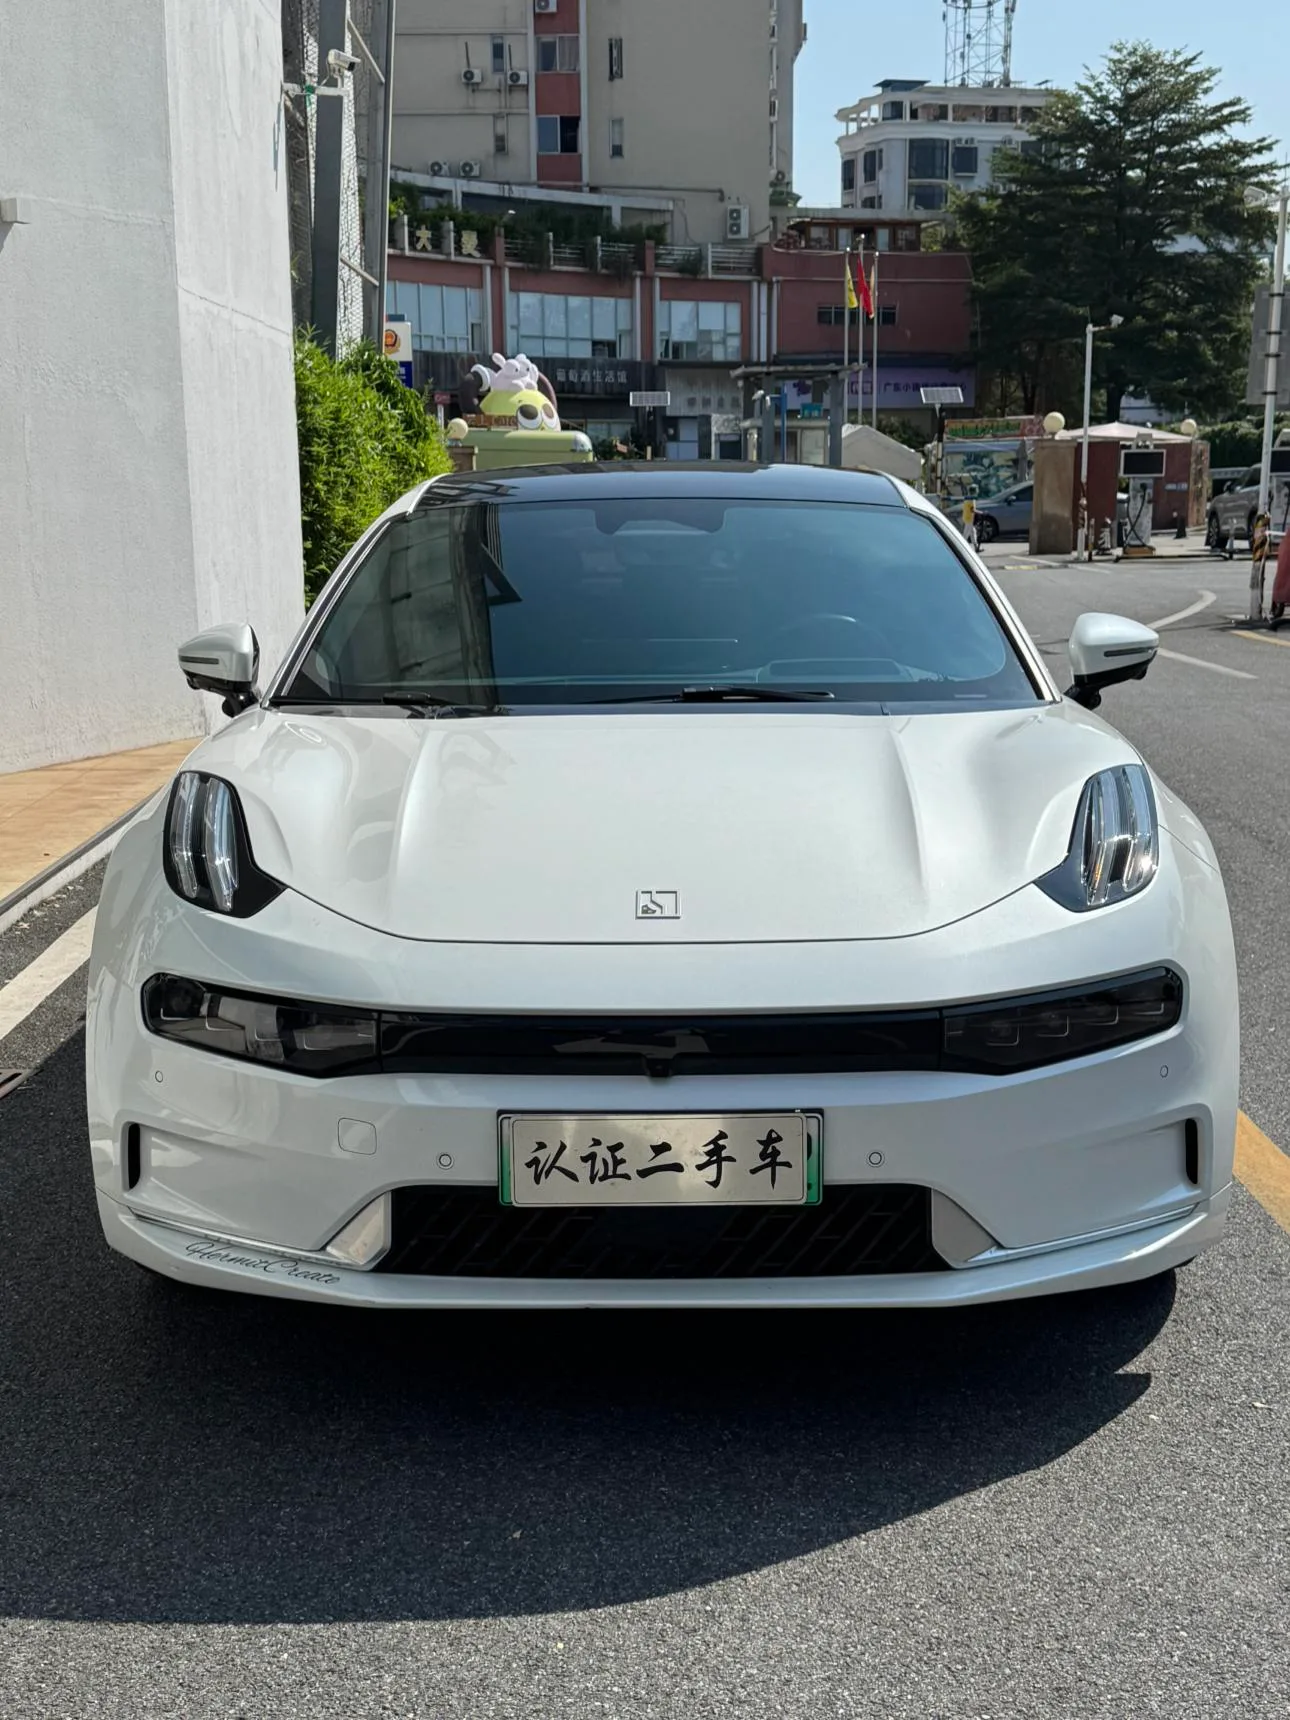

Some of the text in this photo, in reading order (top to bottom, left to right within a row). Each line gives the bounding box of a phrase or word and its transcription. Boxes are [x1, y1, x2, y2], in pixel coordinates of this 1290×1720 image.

[524, 1128, 793, 1190] 认证二手车
